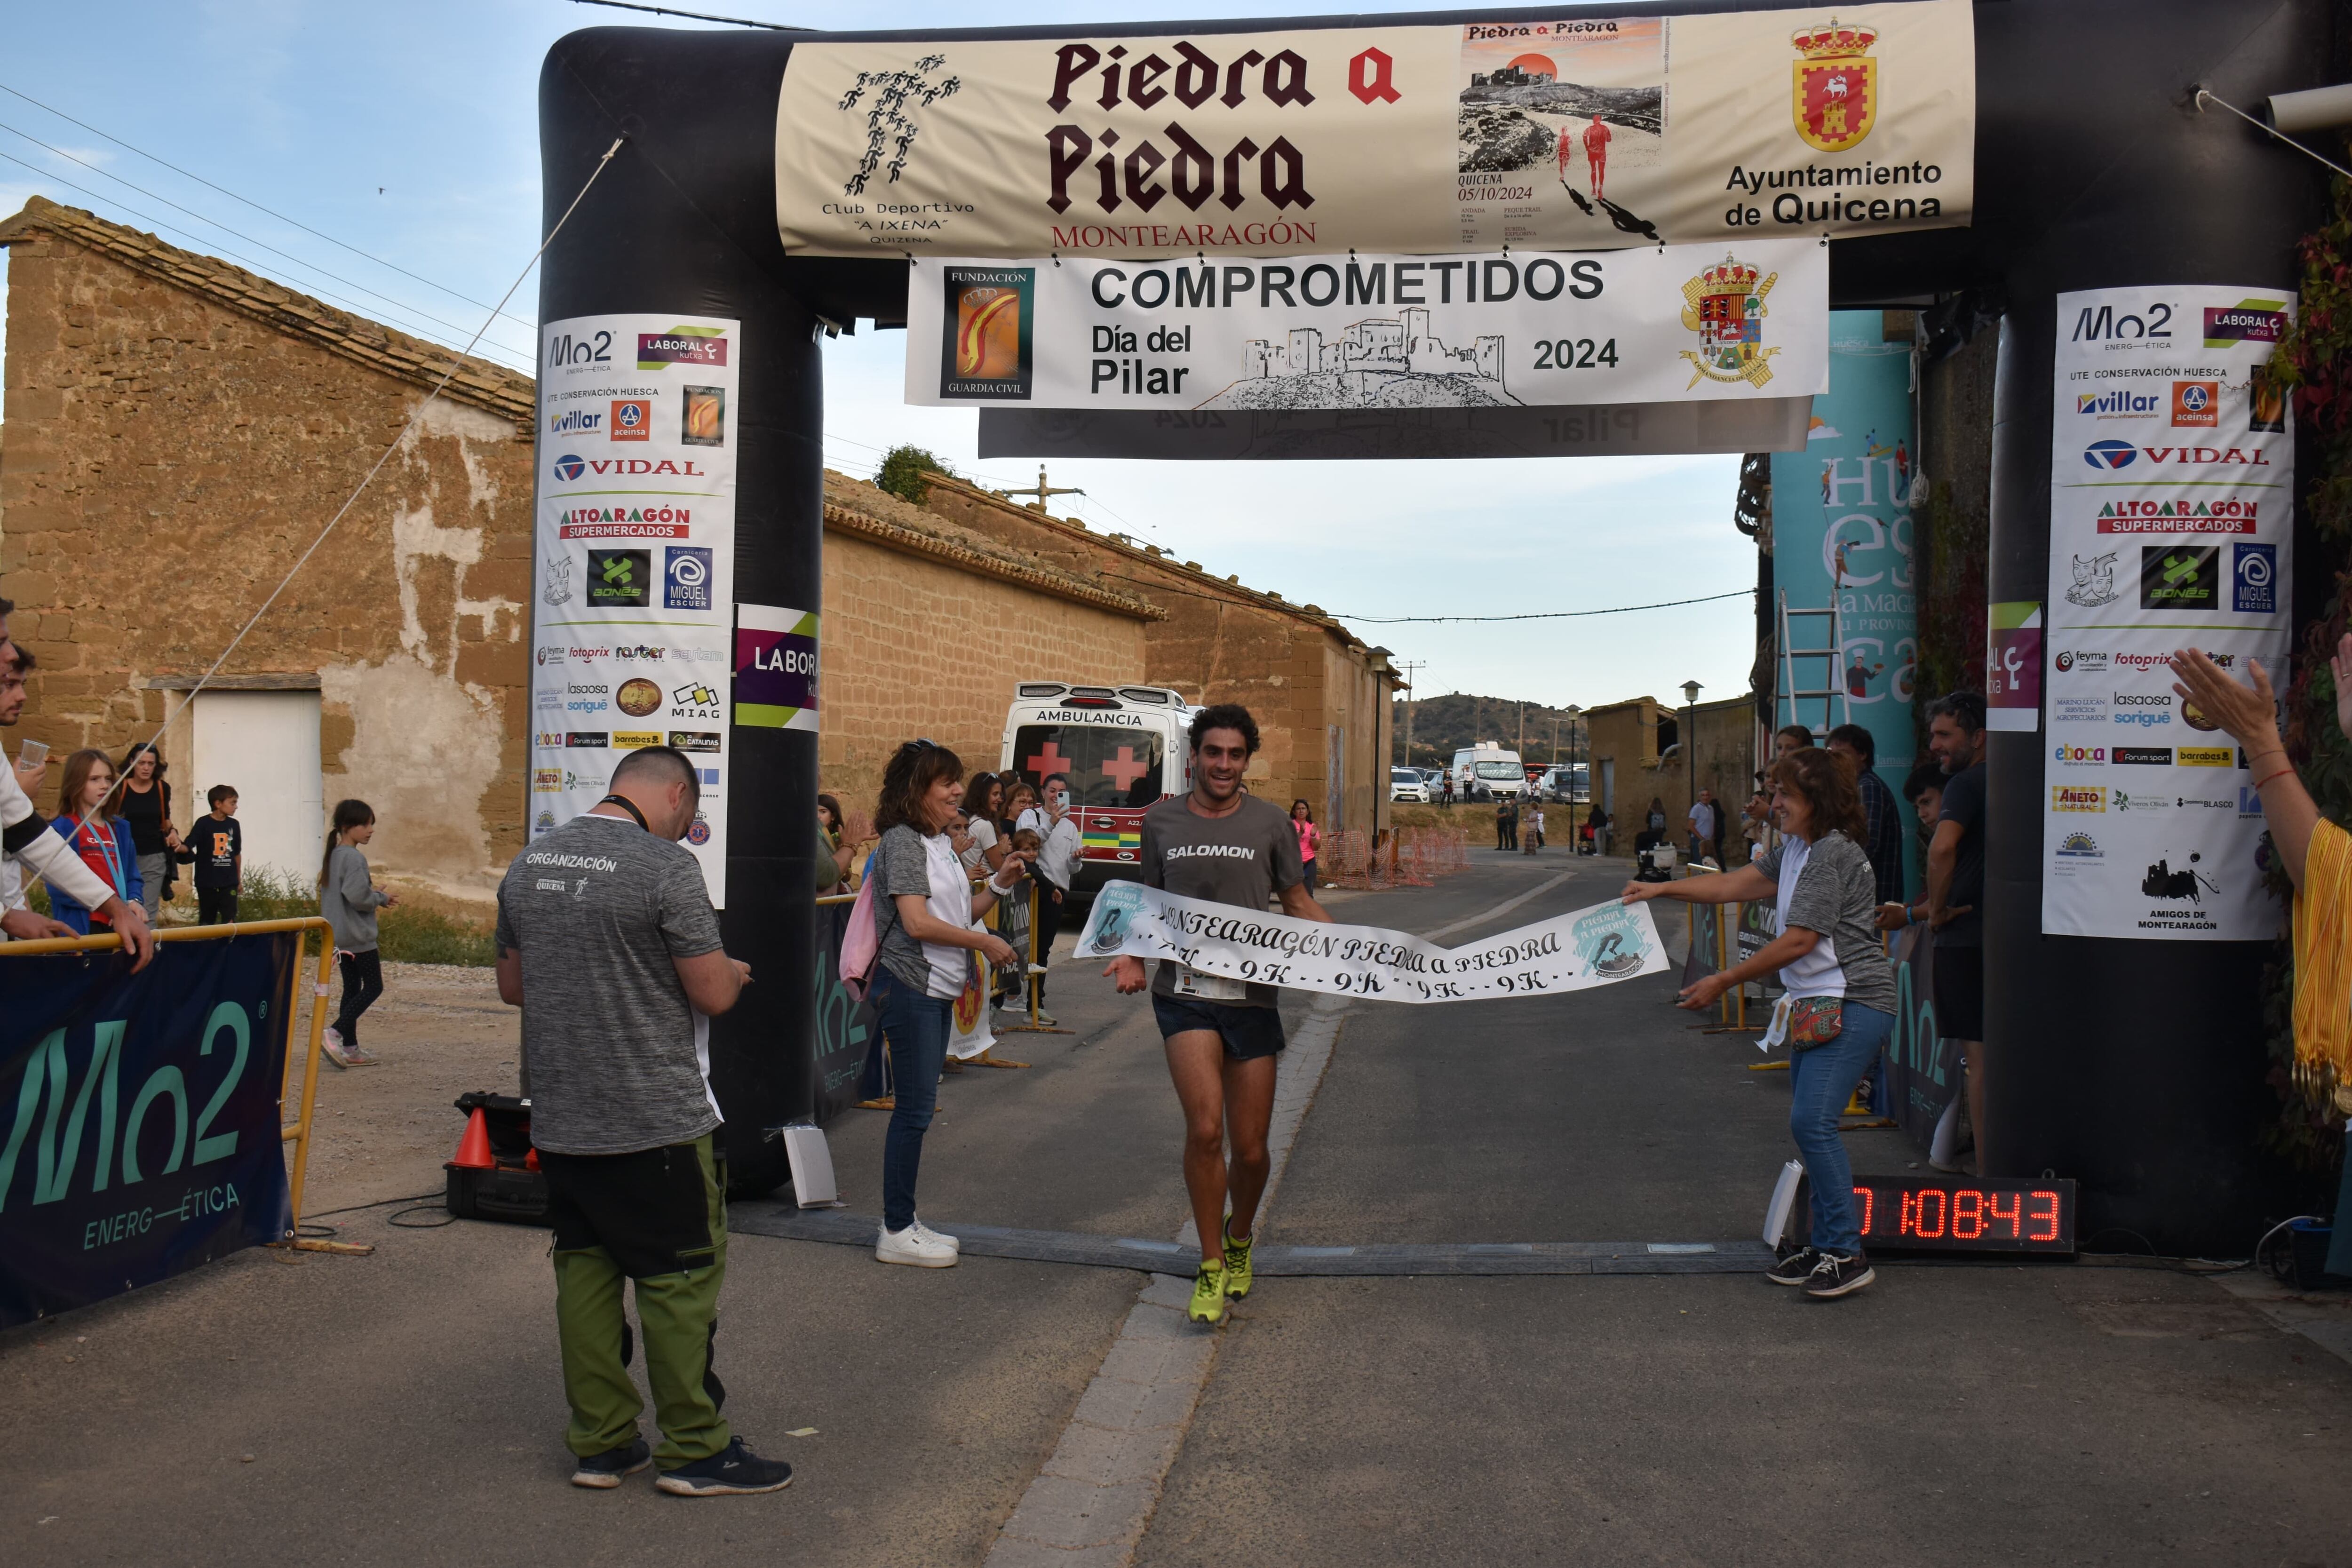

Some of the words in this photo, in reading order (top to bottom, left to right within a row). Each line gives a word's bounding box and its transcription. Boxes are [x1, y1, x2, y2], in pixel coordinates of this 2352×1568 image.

[1468, 25, 1531, 40] Piedra
[1536, 25, 1549, 35] a
[1555, 21, 1619, 34] Piedra
[1047, 40, 1316, 114] Piedra
[1347, 46, 1402, 106] a
[1045, 120, 1315, 214] Piedra
[1458, 174, 1502, 188] QUICENA
[1725, 160, 1942, 193] Ayuntamiento
[1458, 186, 1533, 201] 05/10/2024
[822, 203, 865, 215] Club
[876, 200, 975, 215] Deportivo
[1725, 202, 1762, 226] de
[1771, 193, 1941, 225] Quicena
[870, 235, 933, 245] QUIZENA
[1050, 215, 1318, 249] MONTEARAGÓN
[951, 271, 1027, 283] FUNDACIÓN
[1091, 258, 1605, 309] COMPROMETIDOS
[2072, 303, 2172, 342] Mo2
[2215, 314, 2268, 327] LABORAL
[1091, 325, 1138, 353] Día
[1146, 324, 1192, 353] del
[2247, 327, 2268, 337] kutxa
[549, 330, 612, 368] Mo2
[647, 340, 702, 352] LABORAL
[1533, 337, 1619, 370] 2024
[679, 351, 703, 360] kutxa
[1091, 358, 1190, 395] Pilar
[1694, 360, 1735, 382] COMANDANCIA
[2070, 371, 2090, 381] UTE
[2094, 366, 2180, 379] CONSERVACIÓN
[2184, 368, 2227, 377] HUESCA
[547, 394, 558, 403] UTE
[560, 386, 618, 400] CONSERVACIÓN
[620, 388, 659, 397] HUESCA
[948, 383, 993, 394] GUARDIA
[995, 382, 1024, 393] CIVIL
[2097, 391, 2159, 413] villar
[561, 410, 602, 430] villar
[2142, 447, 2269, 465] VIDAL
[589, 460, 705, 477] VIDAL
[560, 504, 690, 525] ALTOARAGÓN
[2097, 496, 2257, 517] ALTOARAGÓN
[569, 525, 675, 537] SUPERMERCADOS
[2112, 520, 2243, 532] SUPERMERCADOS
[670, 586, 707, 600] MIGUEL
[2239, 586, 2272, 602] MIGUEL
[547, 646, 564, 656] feyma
[569, 645, 610, 660] fotoprix
[616, 645, 666, 659] raster
[2076, 651, 2107, 662] feyma
[2114, 653, 2173, 665] fotoprix
[568, 682, 608, 694] lasaosa
[2114, 692, 2171, 706] lasaosa
[671, 708, 720, 718] MIAG
[1036, 709, 1143, 726] AMBULANCIA
[535, 730, 562, 746] eboca
[615, 734, 652, 744] barrabes
[2055, 743, 2105, 761] eboca
[2180, 751, 2221, 760] barrabes
[1166, 844, 1255, 861] SALOMON
[526, 853, 617, 873] ORGANIZACIÓN
[536, 882, 565, 891] QUICENA
[2149, 910, 2191, 919] AMIGOS
[2193, 911, 2207, 919] DE
[2137, 919, 2217, 930] MONTEARAGÓN
[1456, 931, 1562, 973] PIEDRA
[1597, 959, 1645, 979] MONTEARAGÓN
[1240, 960, 1292, 984] 9K
[1334, 971, 1385, 995] 9K
[1496, 970, 1548, 993] 9K
[0, 1001, 251, 1214] Mo2
